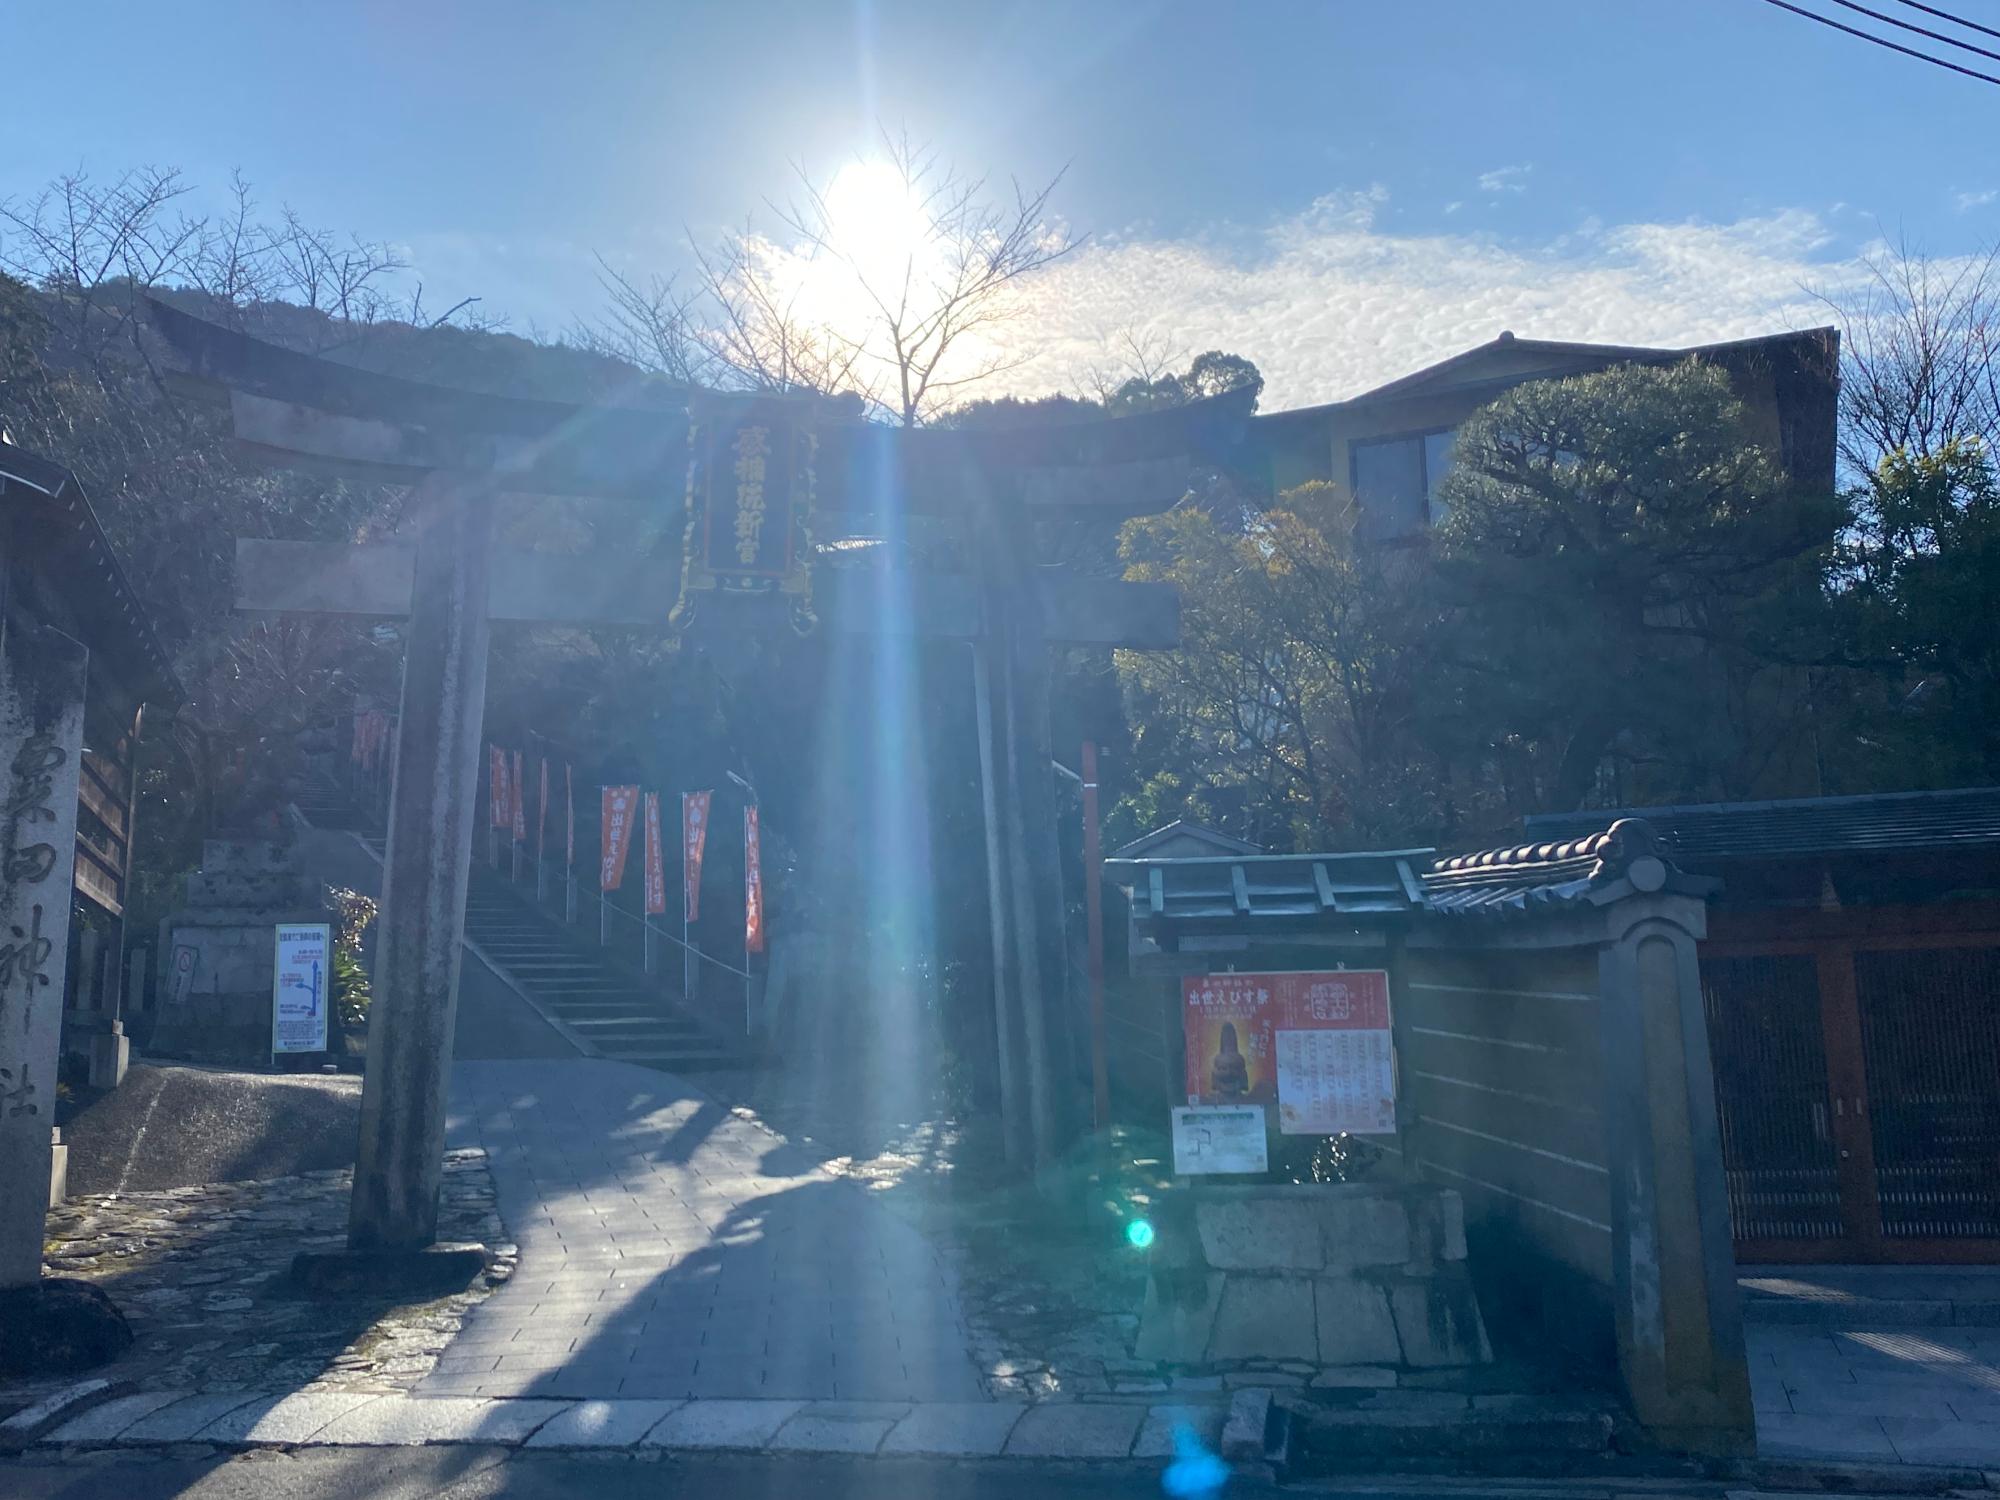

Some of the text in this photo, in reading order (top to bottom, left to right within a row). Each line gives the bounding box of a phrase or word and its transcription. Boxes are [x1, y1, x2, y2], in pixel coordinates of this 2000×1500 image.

[1189, 988, 1270, 1006] 出世えびす祭
